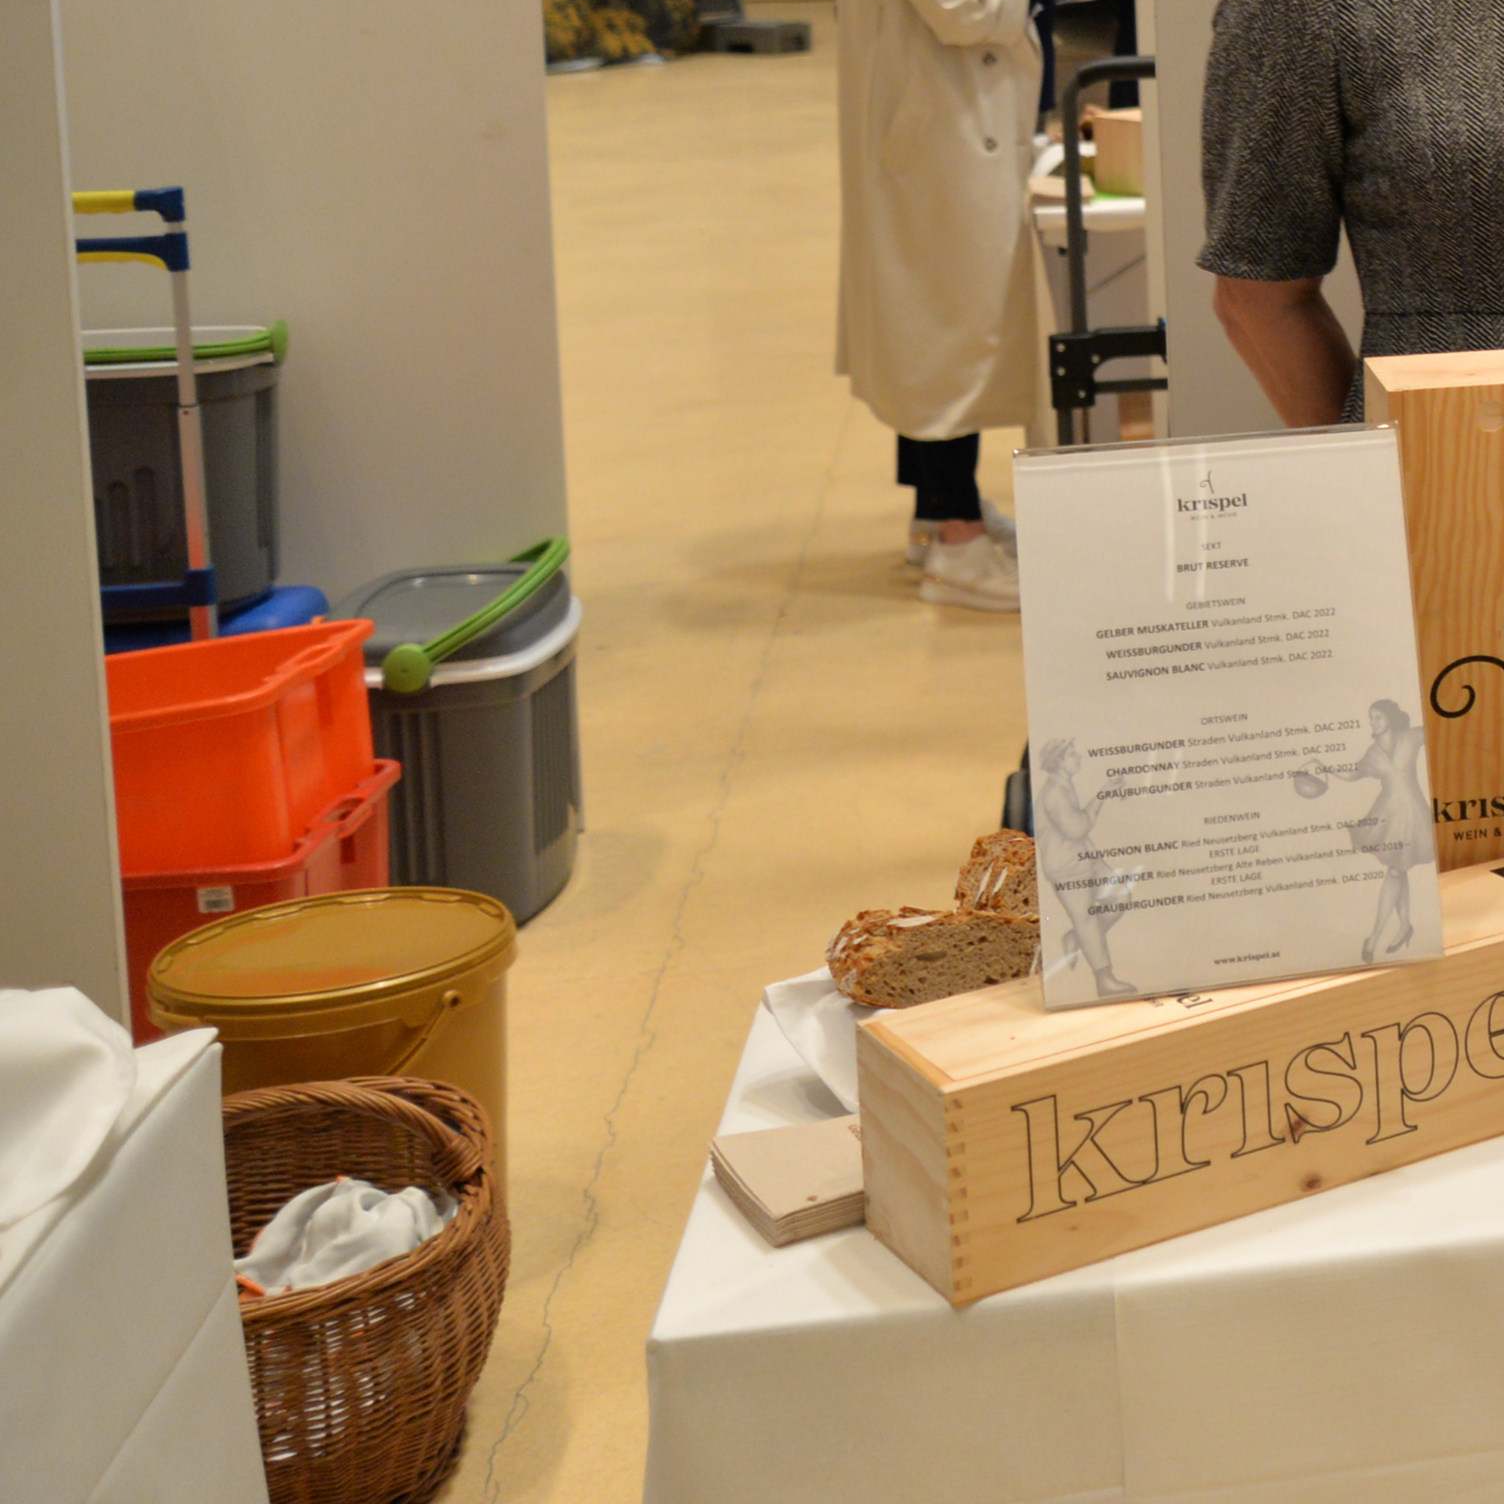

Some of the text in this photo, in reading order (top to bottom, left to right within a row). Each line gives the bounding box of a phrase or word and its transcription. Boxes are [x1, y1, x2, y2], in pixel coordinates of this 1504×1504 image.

[1177, 493, 1248, 513] krispel
[1177, 558, 1249, 573] BRUT RESERVE
[1186, 597, 1246, 611] GEBIETSWEIN
[1096, 608, 1336, 640] GELBER MUSKATELLER Vulkanland Stmk. DAC 2022
[1106, 629, 1330, 659] WEISSBURGUNDER Vulkanland Stmk. DAC 2022
[1106, 650, 1332, 681] SAUVIGNON BLANC Vulkanland Stmk. DAC 2022
[1201, 713, 1248, 726] ORTSWEIN
[1088, 719, 1361, 758] WEISSBURGUNDER Straden Vulkanland Stmk. DAC 2021
[1106, 742, 1347, 778] CHARDONNAY Straden Vulkanland Stmk. DAC 2021
[1097, 781, 1193, 801] GRAUBURGUNDER
[1195, 777, 1231, 790] Straden
[1233, 771, 1284, 786] Vulkanland
[1315, 765, 1334, 776] DAC
[1336, 763, 1359, 774] 2021
[1204, 811, 1261, 825] RIEDENWEIN
[1077, 844, 1142, 861] SAUVIGNON
[1144, 840, 1179, 853] BLANC
[1181, 837, 1201, 849] Ried
[1203, 831, 1258, 848] Neusetzberg
[1260, 825, 1308, 840] Vulkanland
[1310, 822, 1334, 834] Stmk.
[1337, 819, 1356, 830] DAC
[1453, 828, 1489, 842] WEIN
[1494, 827, 1502, 837] &
[1209, 844, 1260, 859] ERSTE LAGE
[1055, 871, 1154, 892] WEISSBURGUNDER
[1156, 868, 1176, 879] Ried
[1178, 862, 1233, 879] Neusetzberg
[1236, 859, 1254, 870] Alte
[1255, 855, 1284, 867] Reben
[1285, 849, 1334, 863] Vulkanland
[1336, 846, 1359, 857] Stmk.
[1361, 843, 1380, 854] DAC
[1211, 872, 1263, 886] ERSTE LAGE
[1087, 870, 1385, 917] GRAUBURGUNDER Ried Neusetzberg Vulkanland Stmk. DAC 2020
[1214, 951, 1281, 966] www.krispel.at
